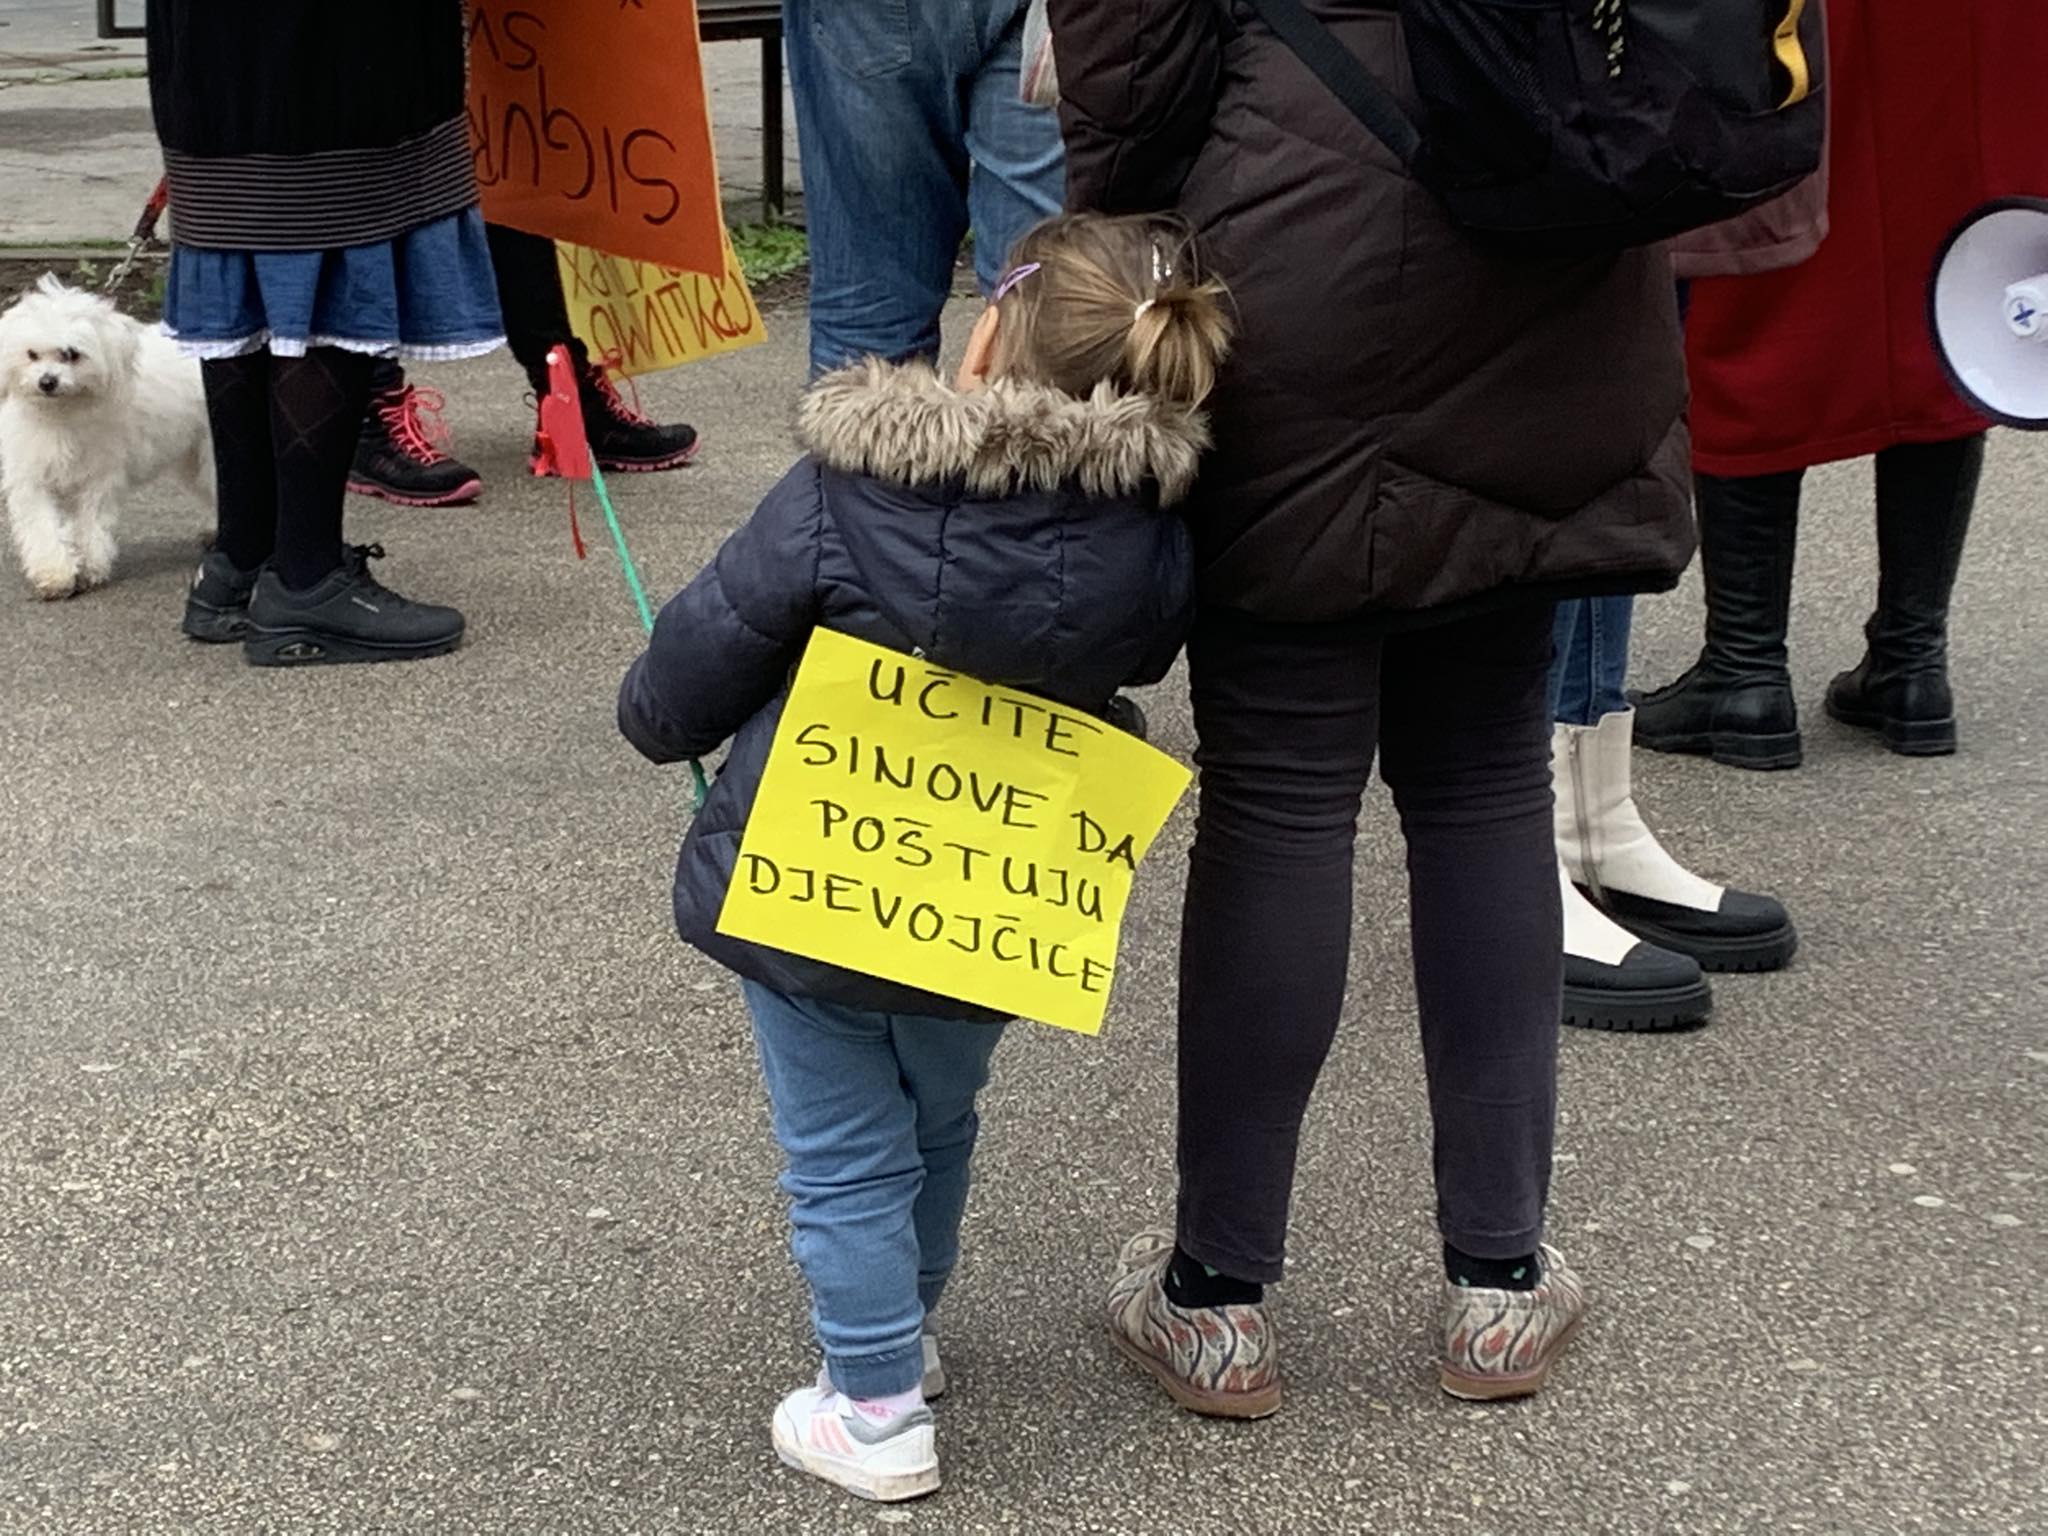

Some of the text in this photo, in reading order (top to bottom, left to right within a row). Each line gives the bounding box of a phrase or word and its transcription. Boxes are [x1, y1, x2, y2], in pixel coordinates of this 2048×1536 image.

[868, 657, 1104, 758] UČITE
[795, 723, 1138, 872] SINOVE DA
[810, 799, 1104, 922] POŠTUJU
[741, 852, 1112, 993] DJEVOJČICE
